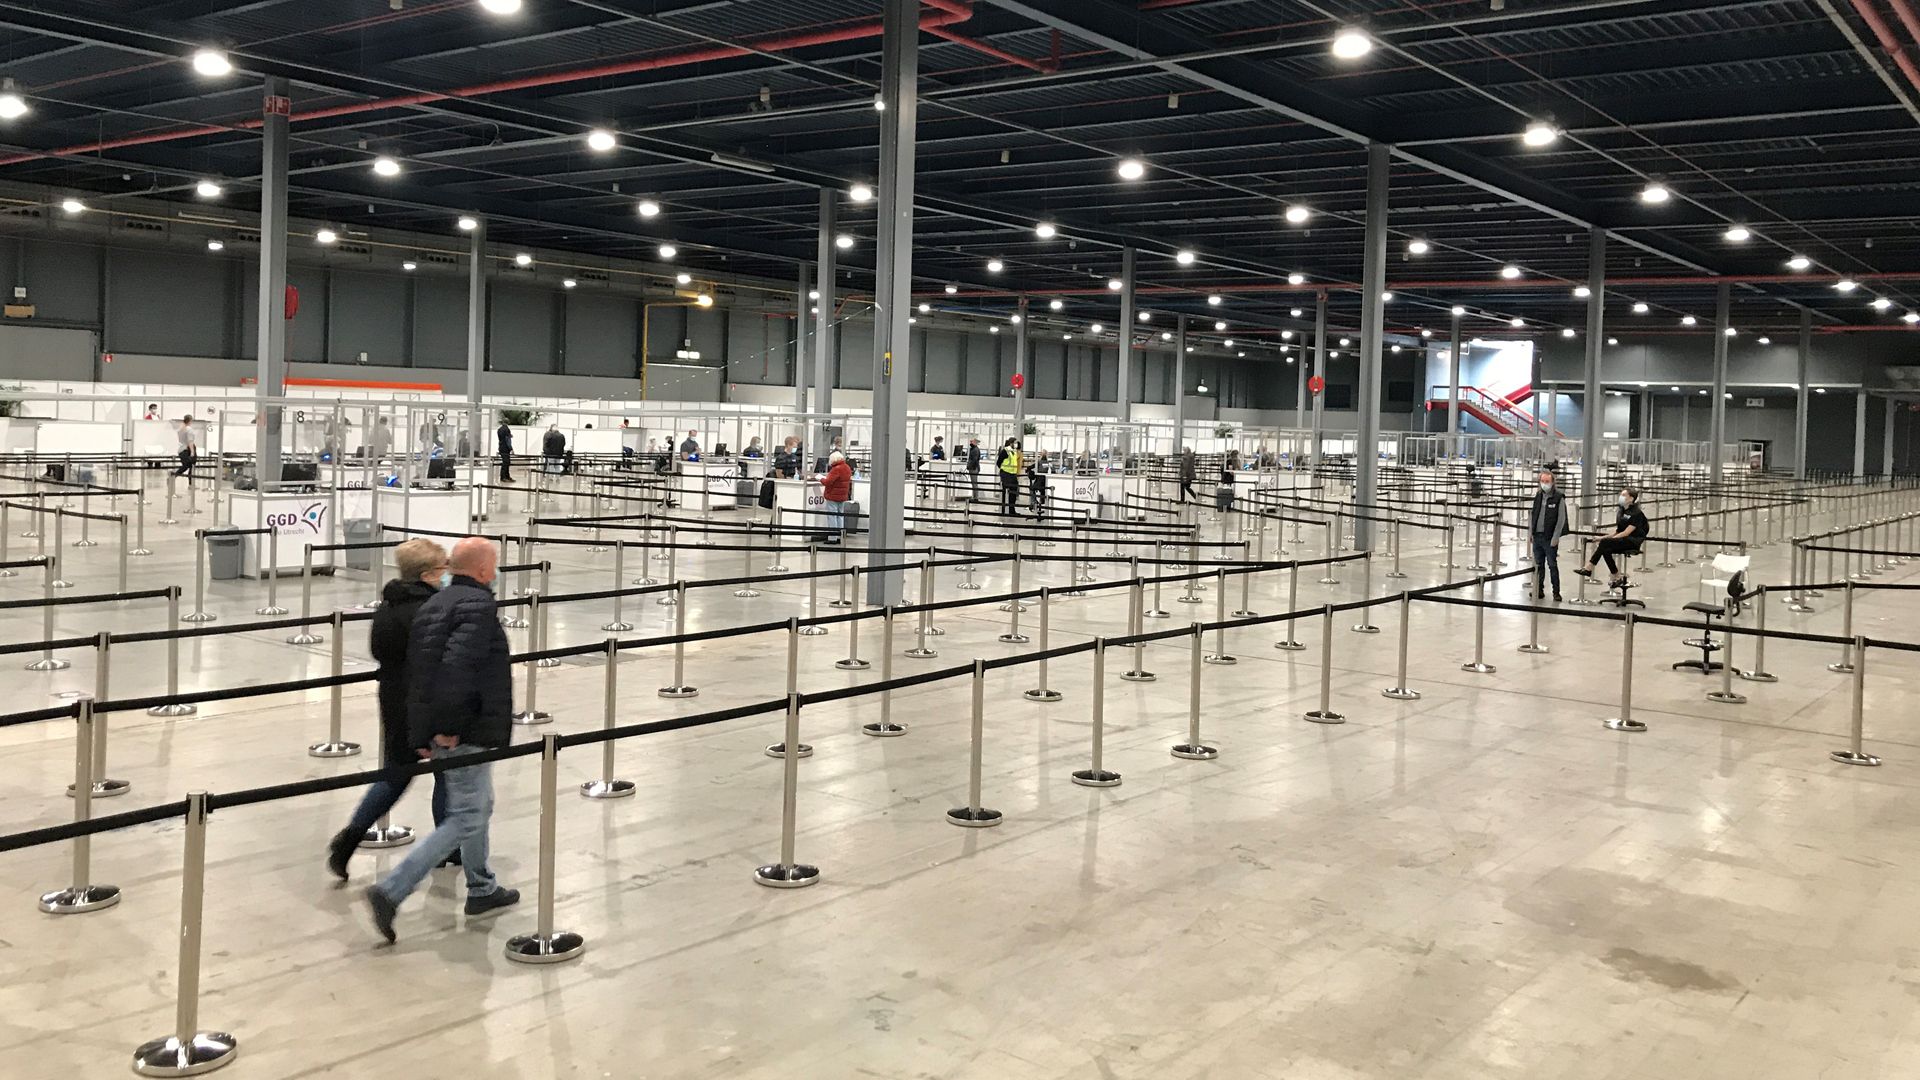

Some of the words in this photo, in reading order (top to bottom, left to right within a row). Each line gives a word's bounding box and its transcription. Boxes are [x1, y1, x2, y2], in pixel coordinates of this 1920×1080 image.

[296, 410, 304, 423] 8
[437, 412, 445, 425] 9
[808, 495, 825, 505] GGD
[266, 513, 297, 527] GGD
